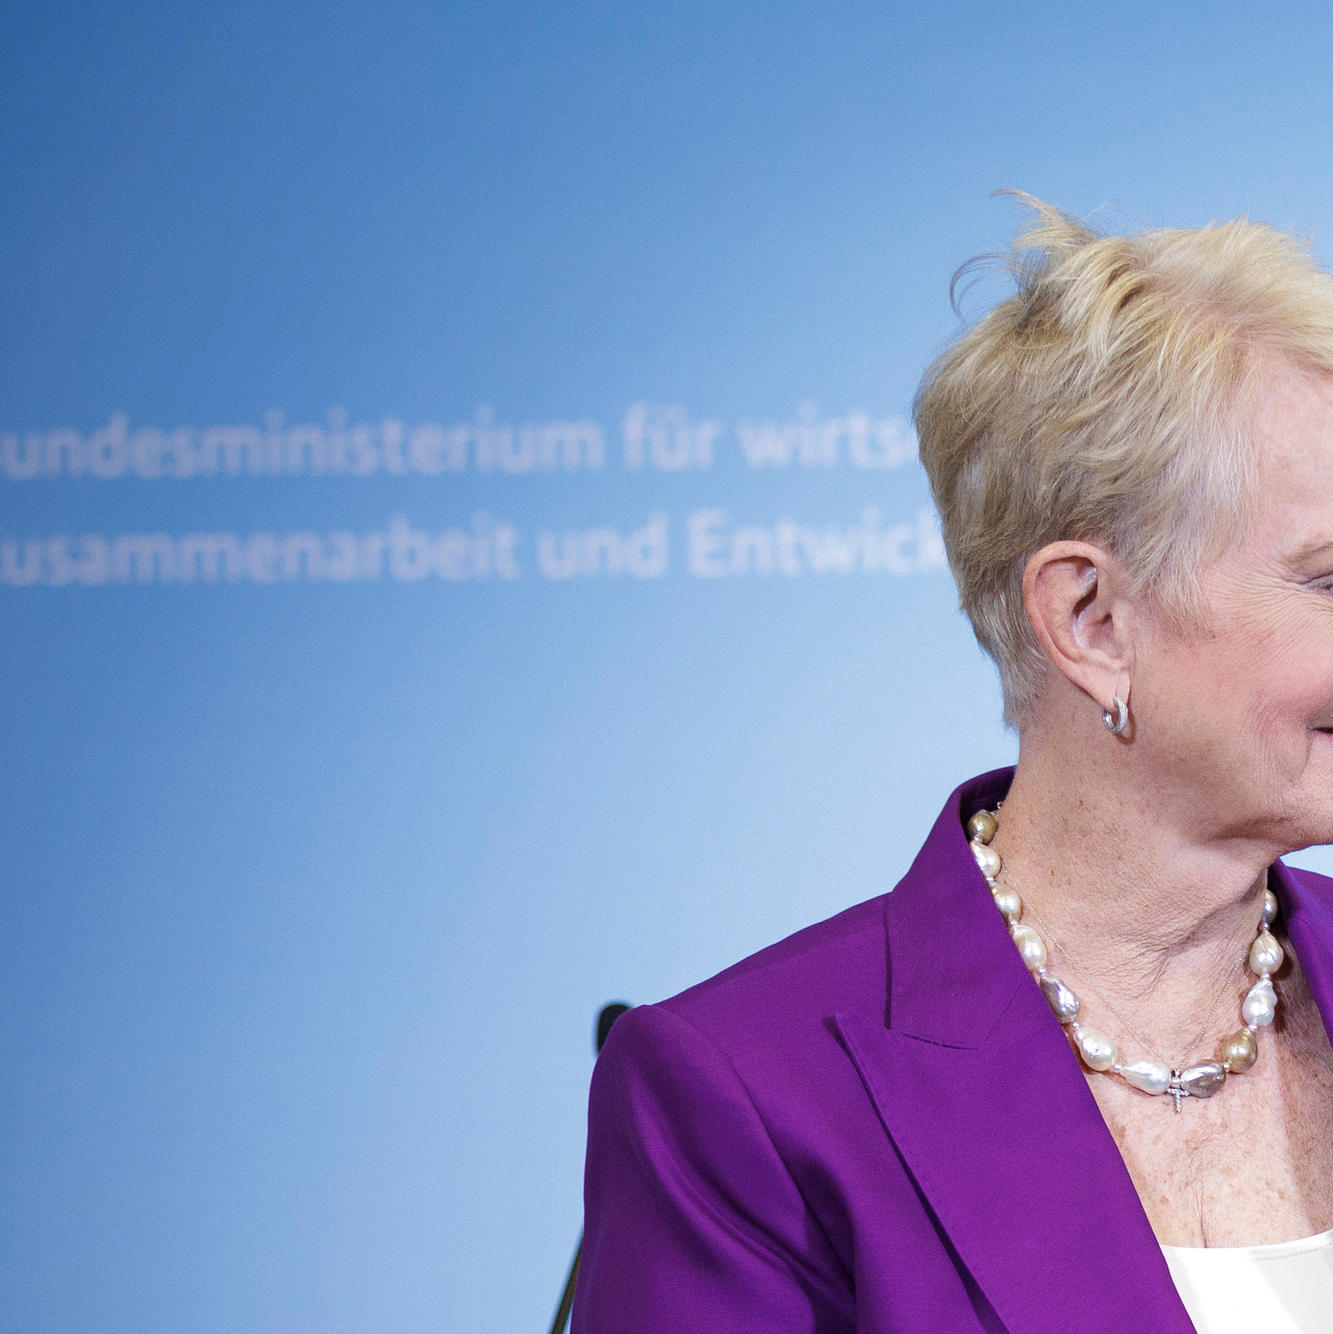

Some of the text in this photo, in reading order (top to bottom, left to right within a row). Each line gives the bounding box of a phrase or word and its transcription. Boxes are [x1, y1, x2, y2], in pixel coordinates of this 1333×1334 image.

[1, 404, 604, 478] undesministerium
[622, 401, 722, 469] für
[1, 510, 519, 586] usammenarbeit
[538, 510, 669, 579] und
